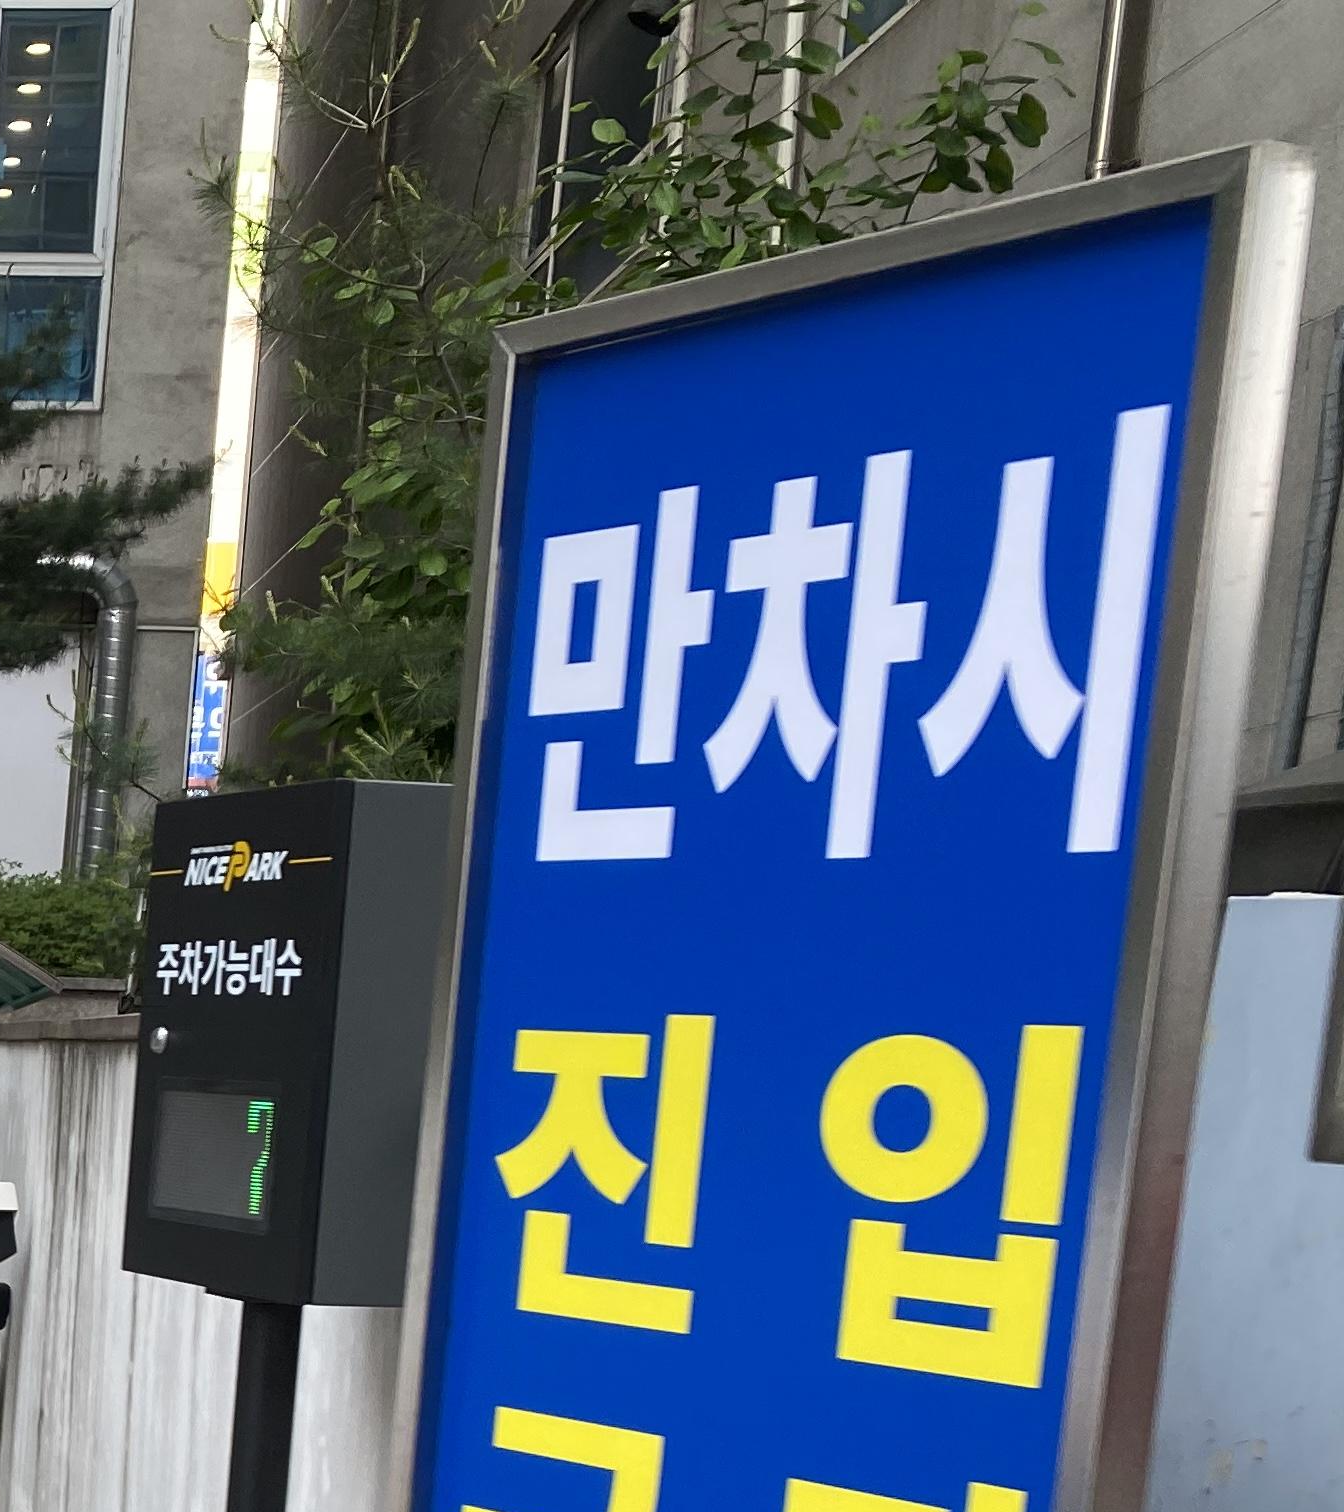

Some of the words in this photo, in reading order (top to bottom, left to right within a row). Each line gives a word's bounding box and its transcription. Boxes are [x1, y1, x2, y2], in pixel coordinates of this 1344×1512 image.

[528, 404, 1172, 861] 만차시
[184, 841, 289, 892] NICEPARK
[156, 938, 303, 996] 주차가능대수
[247, 1100, 276, 1217] 7
